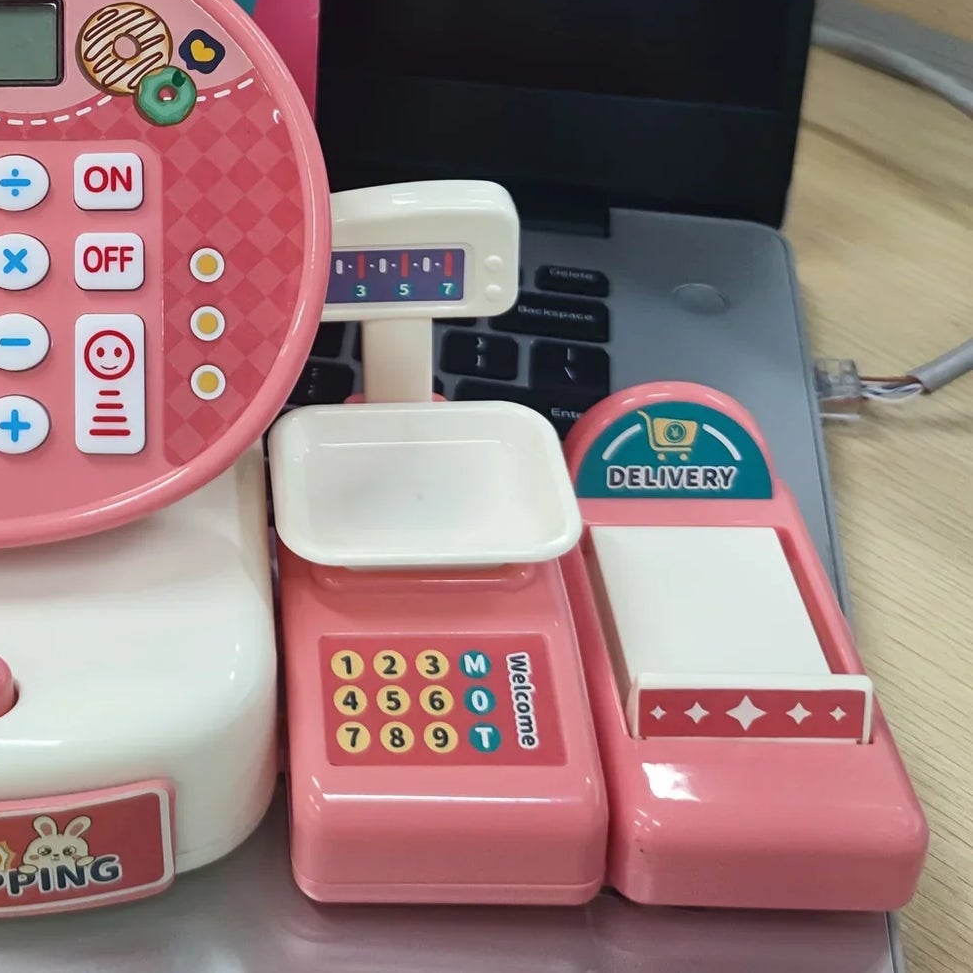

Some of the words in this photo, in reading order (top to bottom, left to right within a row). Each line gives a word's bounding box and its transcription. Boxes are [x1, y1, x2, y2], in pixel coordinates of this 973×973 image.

[83, 166, 133, 194] ON
[83, 246, 134, 273] OFF
[548, 267, 595, 281] Delete
[355, 284, 367, 297] 3
[398, 283, 410, 296] 5
[442, 282, 453, 295] 7
[517, 305, 595, 322] Backspace
[550, 407, 584, 420] Ente
[607, 466, 737, 489] DELIVERY
[341, 655, 353, 675] 1
[382, 655, 397, 675] 2
[425, 655, 440, 675] 3
[342, 690, 358, 710] 4
[386, 690, 401, 711] 5
[428, 690, 445, 711] 6
[507, 653, 538, 748] Welcome
[345, 727, 360, 747] 7
[389, 727, 405, 748] 8
[432, 727, 449, 748] 9
